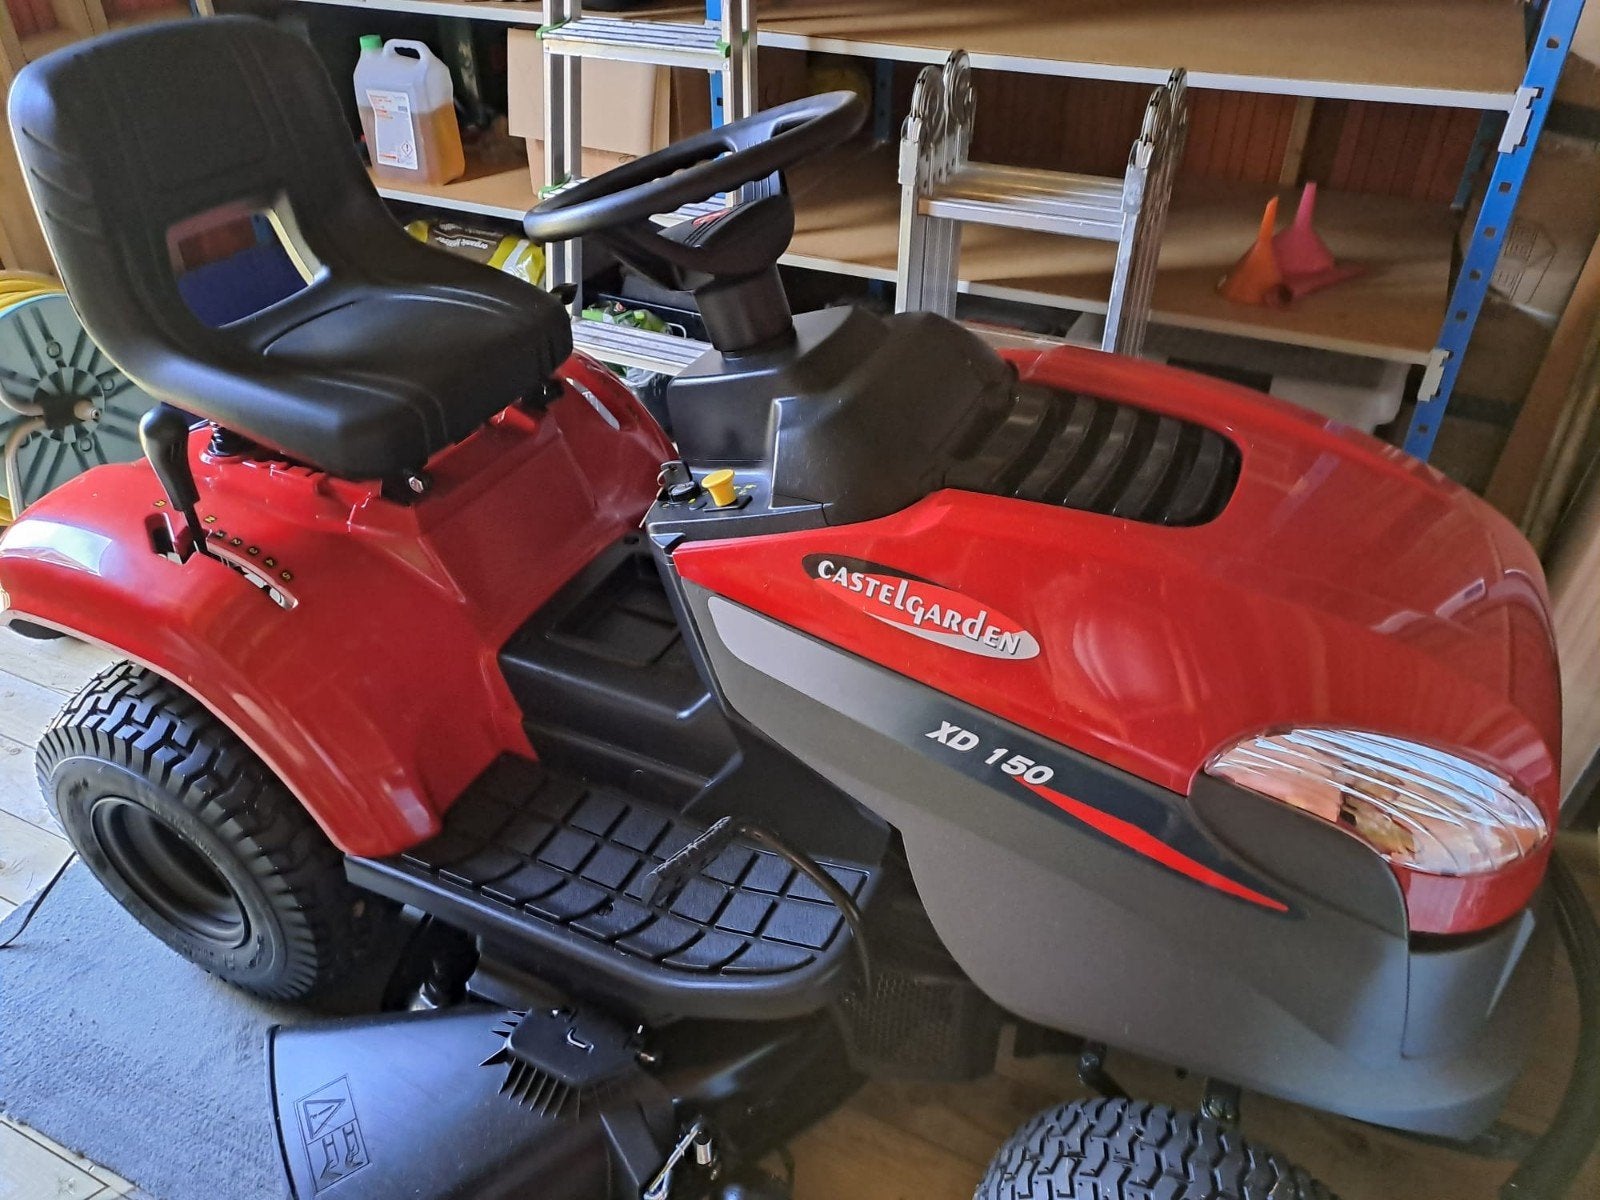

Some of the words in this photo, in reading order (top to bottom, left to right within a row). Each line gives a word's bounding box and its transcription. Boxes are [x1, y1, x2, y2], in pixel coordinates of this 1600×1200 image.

[281, 571, 292, 581] 5
[925, 720, 979, 752] XD
[985, 748, 1054, 785] 150
